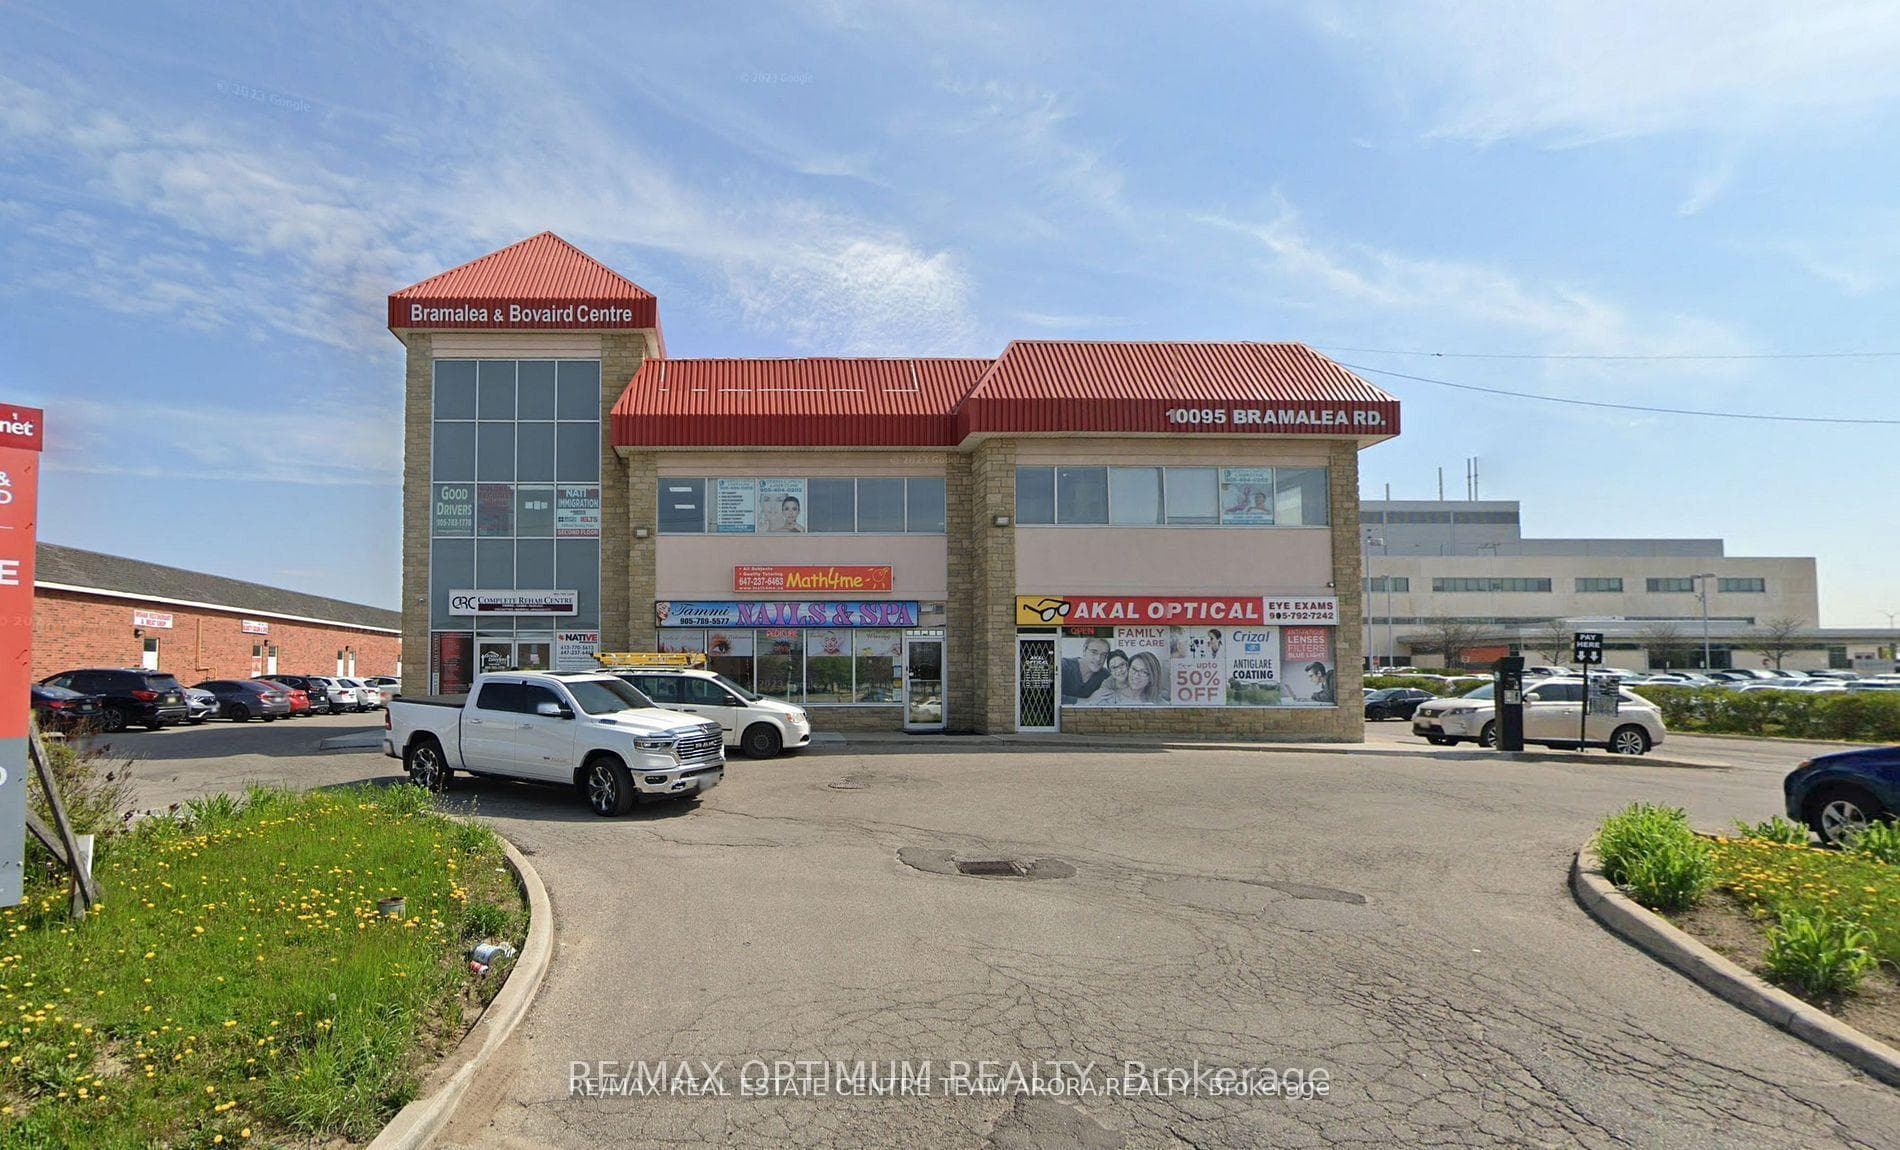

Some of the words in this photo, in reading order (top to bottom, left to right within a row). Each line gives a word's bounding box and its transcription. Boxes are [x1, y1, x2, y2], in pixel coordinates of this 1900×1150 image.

[411, 304, 488, 322] Bramalea
[493, 310, 504, 322] &
[509, 304, 574, 322] Bovaird
[577, 305, 633, 322] Centre
[1165, 409, 1226, 424] 10095
[1233, 409, 1349, 425] BRAMALEA
[1353, 411, 1386, 425] RD.
[441, 486, 468, 500] GOOD
[437, 502, 473, 516] DRIVERS
[786, 567, 864, 590] Math4me
[544, 596, 573, 604] CENTRE
[671, 603, 730, 617] Tammi
[1074, 602, 1140, 619] AKAL
[1148, 601, 1258, 620] OPTICAL
[1269, 602, 1290, 610] EYE
[1295, 602, 1333, 610] EXAMS
[736, 602, 827, 626] NAILS
[832, 602, 856, 626] &
[859, 602, 914, 626] SPA
[1070, 627, 1095, 635] OPEN
[1118, 628, 1165, 638] FAMILY
[1232, 630, 1270, 643] Crizal
[565, 633, 598, 641] NATIVE
[1287, 635, 1325, 644] LENSES
[1118, 639, 1136, 647] EYE
[1139, 639, 1165, 647] CARE
[1287, 644, 1325, 652] FILTERS
[1576, 641, 1600, 649] HERE
[1196, 662, 1218, 670] upto
[1233, 658, 1273, 669] ANTIGLARE
[1177, 670, 1220, 686] 50%
[1232, 670, 1274, 680] COATING
[1177, 687, 1219, 702] OFF
